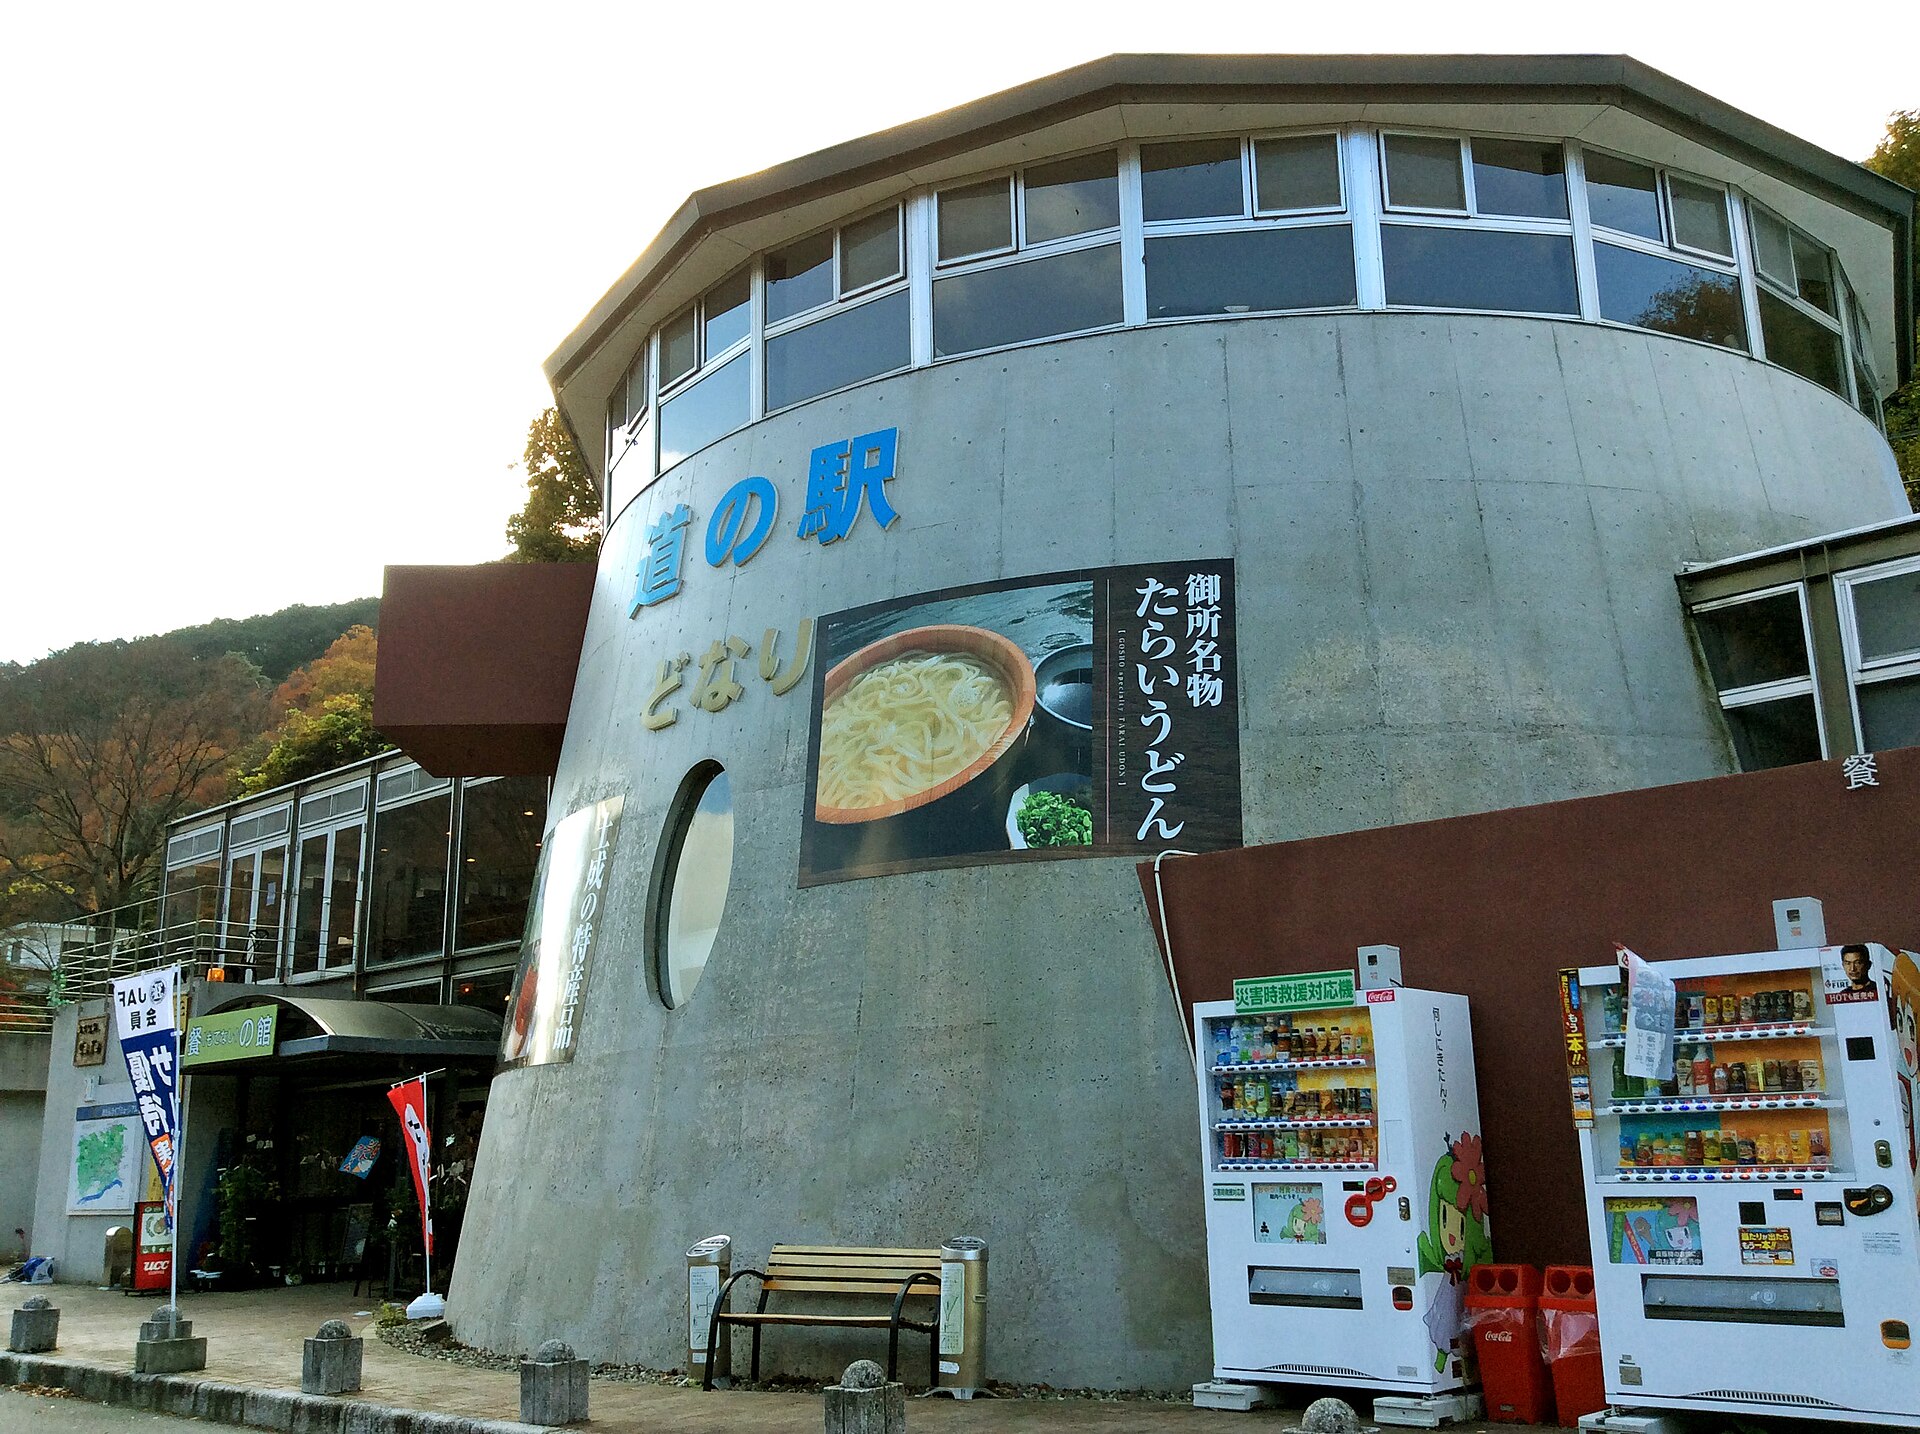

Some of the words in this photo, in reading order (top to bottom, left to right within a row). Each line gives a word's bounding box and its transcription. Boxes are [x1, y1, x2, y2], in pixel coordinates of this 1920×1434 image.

[628, 427, 900, 618] 道の駅
[639, 617, 818, 731] どなり
[1184, 573, 1224, 708] 御所名物
[1135, 577, 1185, 842] たらいうどん
[1842, 753, 1880, 790] 餐
[552, 812, 614, 1050] 土成の特産品
[1235, 978, 1354, 1007] 災害時救援対応機
